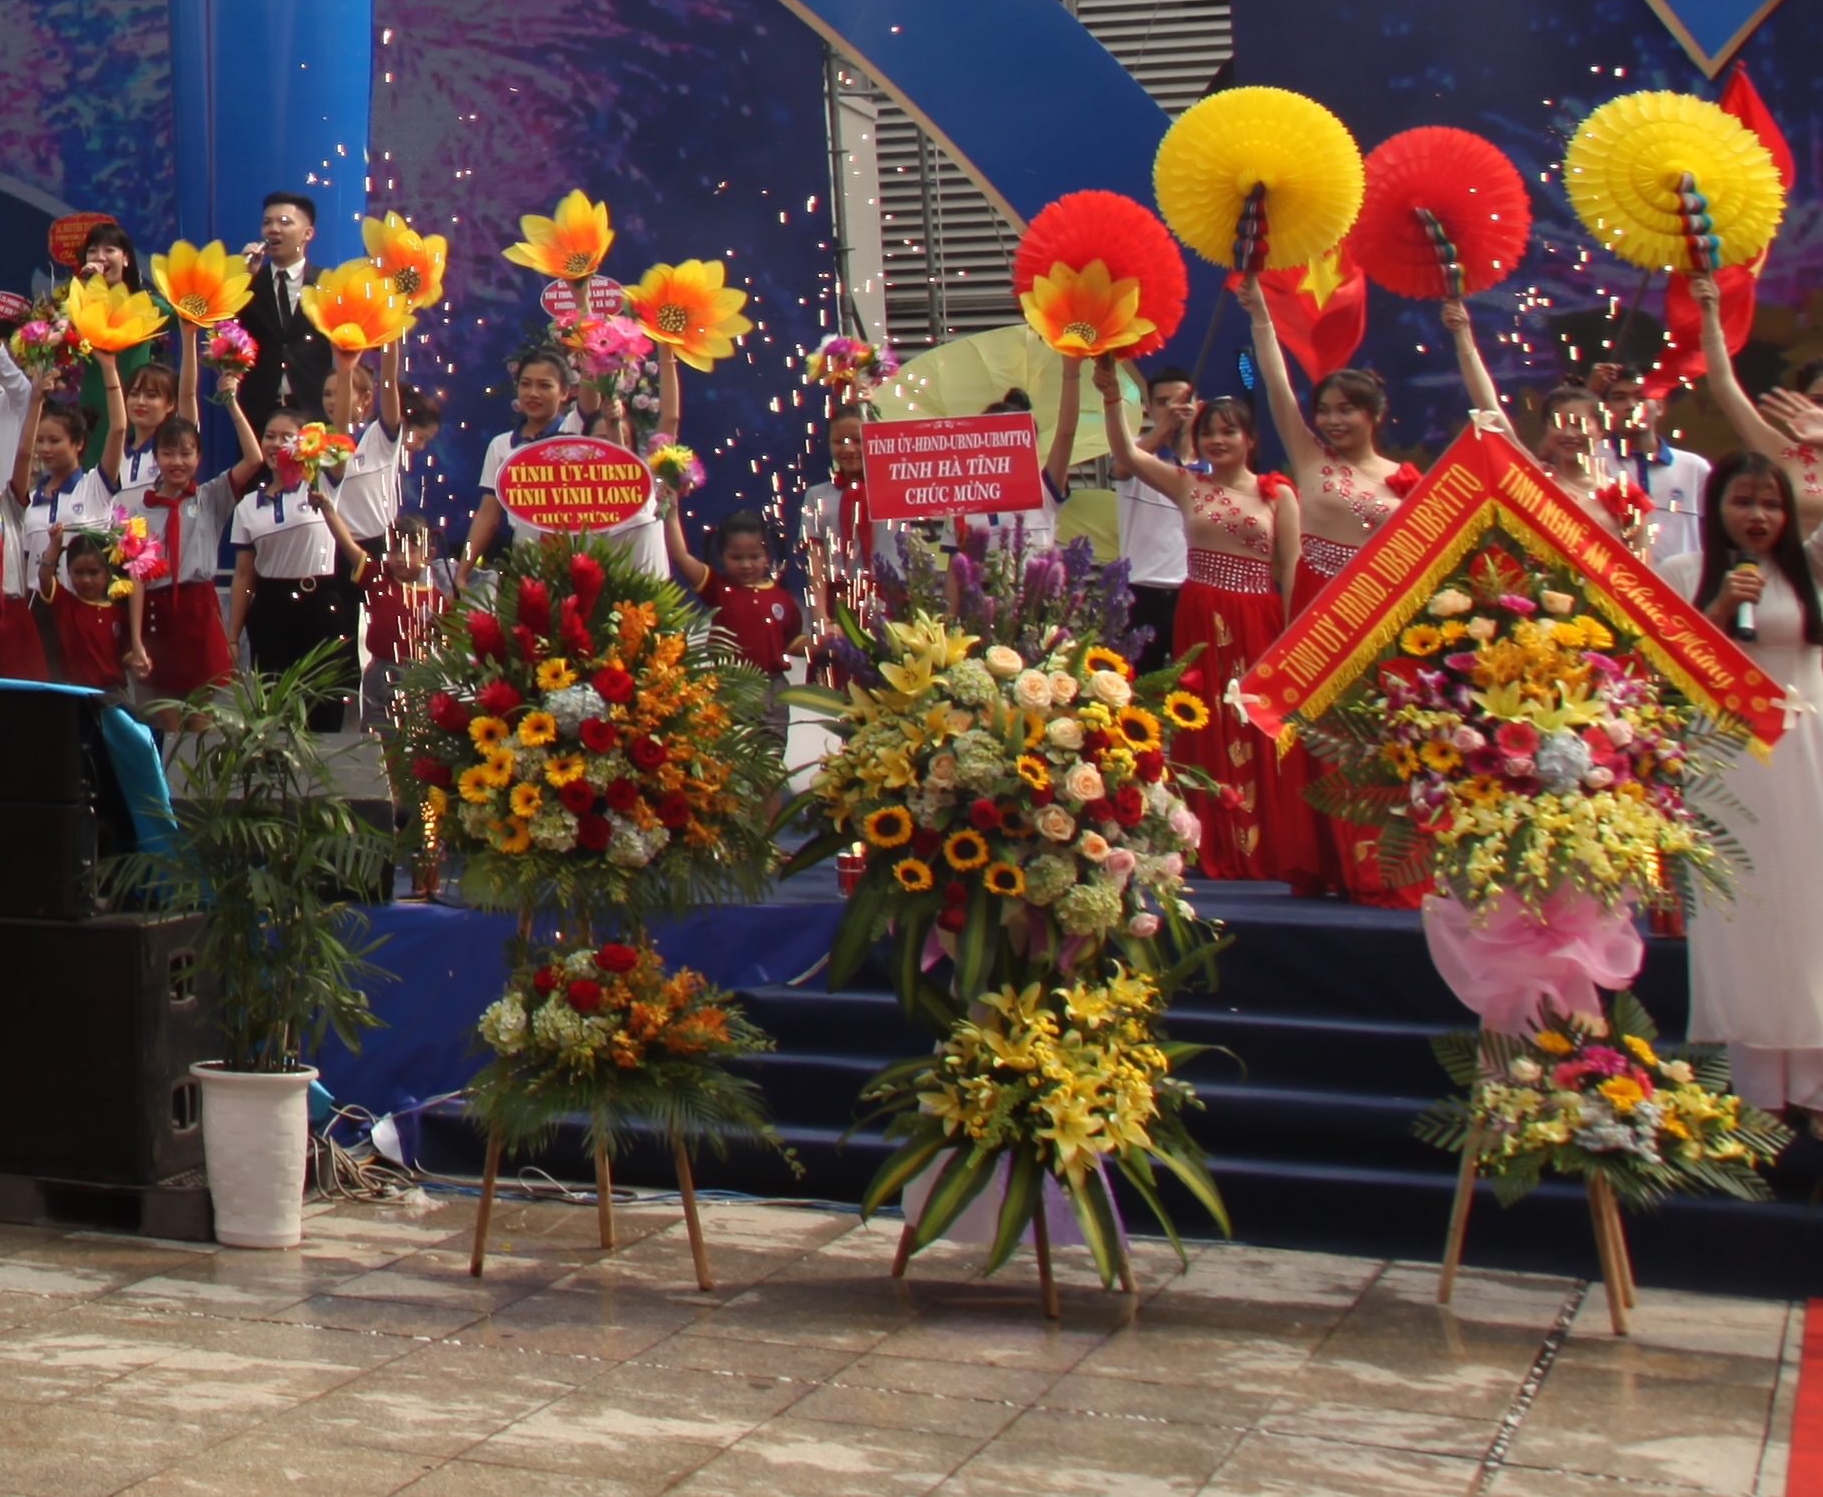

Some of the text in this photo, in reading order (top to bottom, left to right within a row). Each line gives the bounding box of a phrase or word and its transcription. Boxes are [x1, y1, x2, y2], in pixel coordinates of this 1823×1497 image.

[868, 434, 895, 455] TỈNH
[507, 461, 642, 483] TỈNH ỦY-UBND
[889, 454, 1010, 480] TỈNH HÀ TĨNH
[506, 483, 643, 506] TỈNH VĨNH LONG
[905, 480, 1001, 505] CHÚC MỪNG
[532, 509, 620, 524] CHÚC MỪNG
[1498, 462, 1545, 513] TỈNH
[1537, 501, 1591, 554] NGHỆ
[1581, 543, 1612, 575] AN
[1609, 563, 1671, 632] Chúc
[1278, 636, 1330, 688] TỈNH
